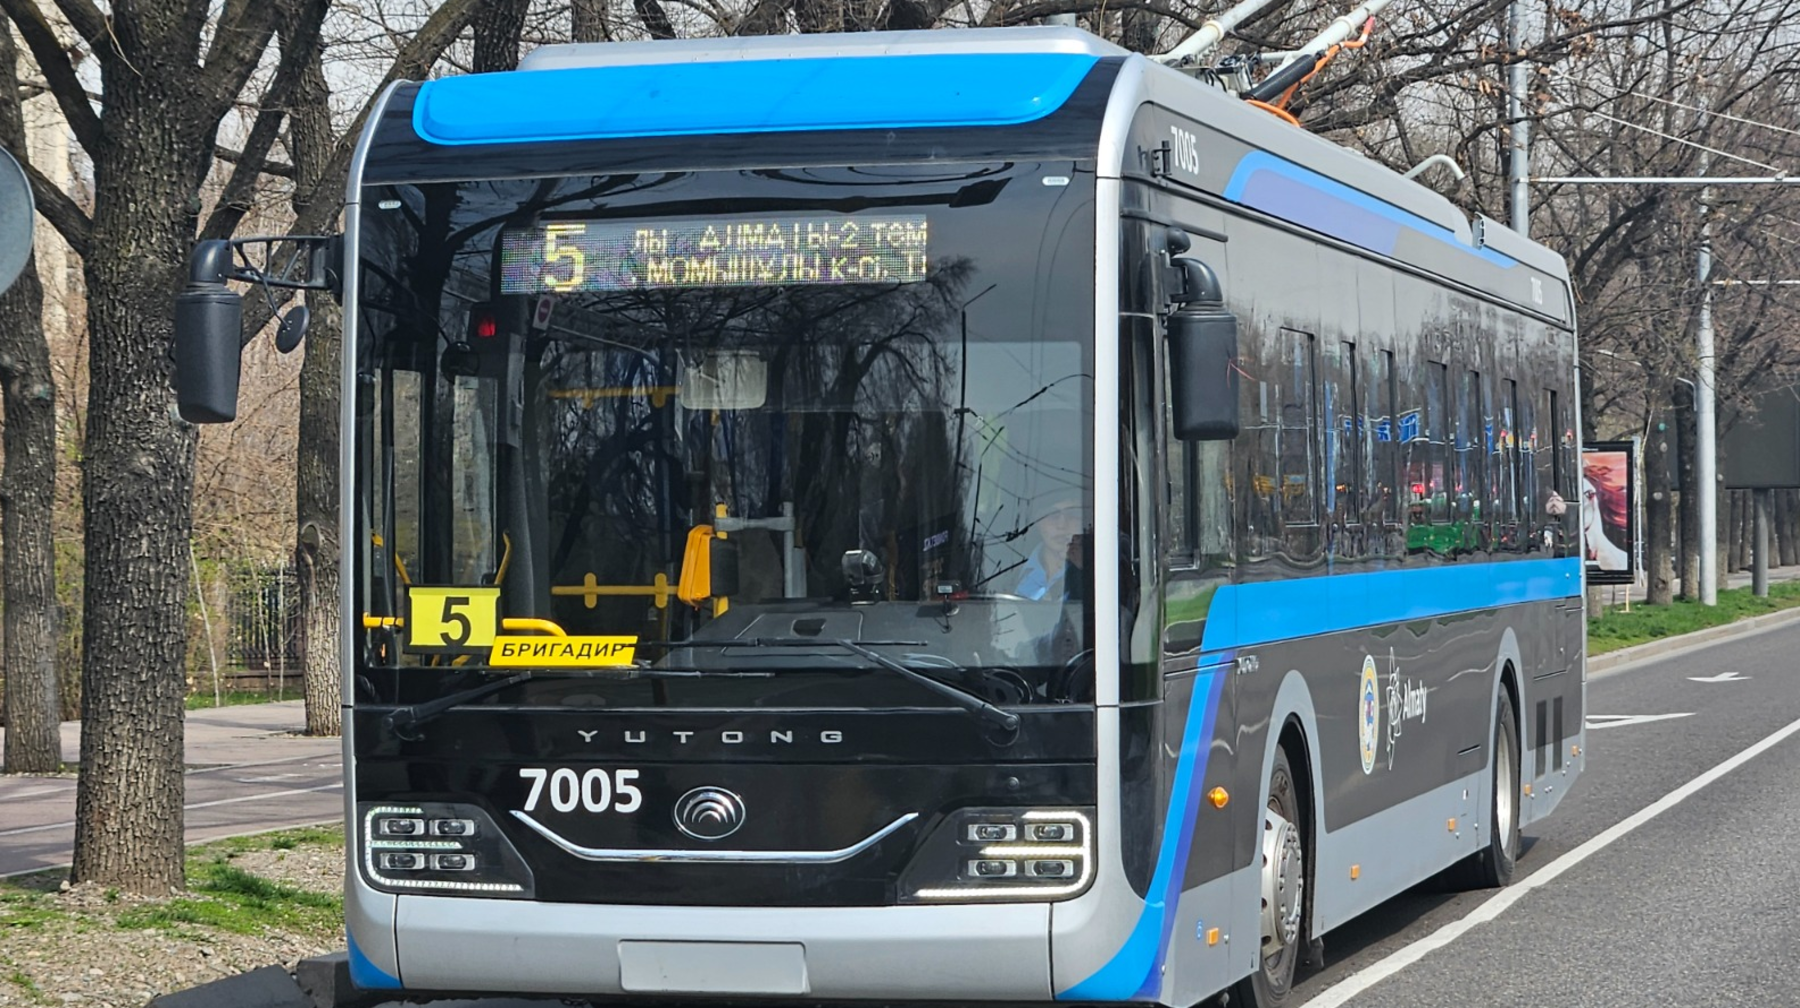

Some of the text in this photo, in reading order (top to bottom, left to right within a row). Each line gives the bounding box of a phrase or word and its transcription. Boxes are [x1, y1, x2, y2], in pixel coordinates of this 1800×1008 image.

[1171, 126, 1199, 175] 7005
[544, 224, 587, 292] 5
[439, 595, 471, 645] 5
[501, 642, 626, 660] БРИГАДИР
[1402, 678, 1428, 724] Almaty
[577, 730, 844, 744] YUTONG
[518, 767, 643, 813] 7005
